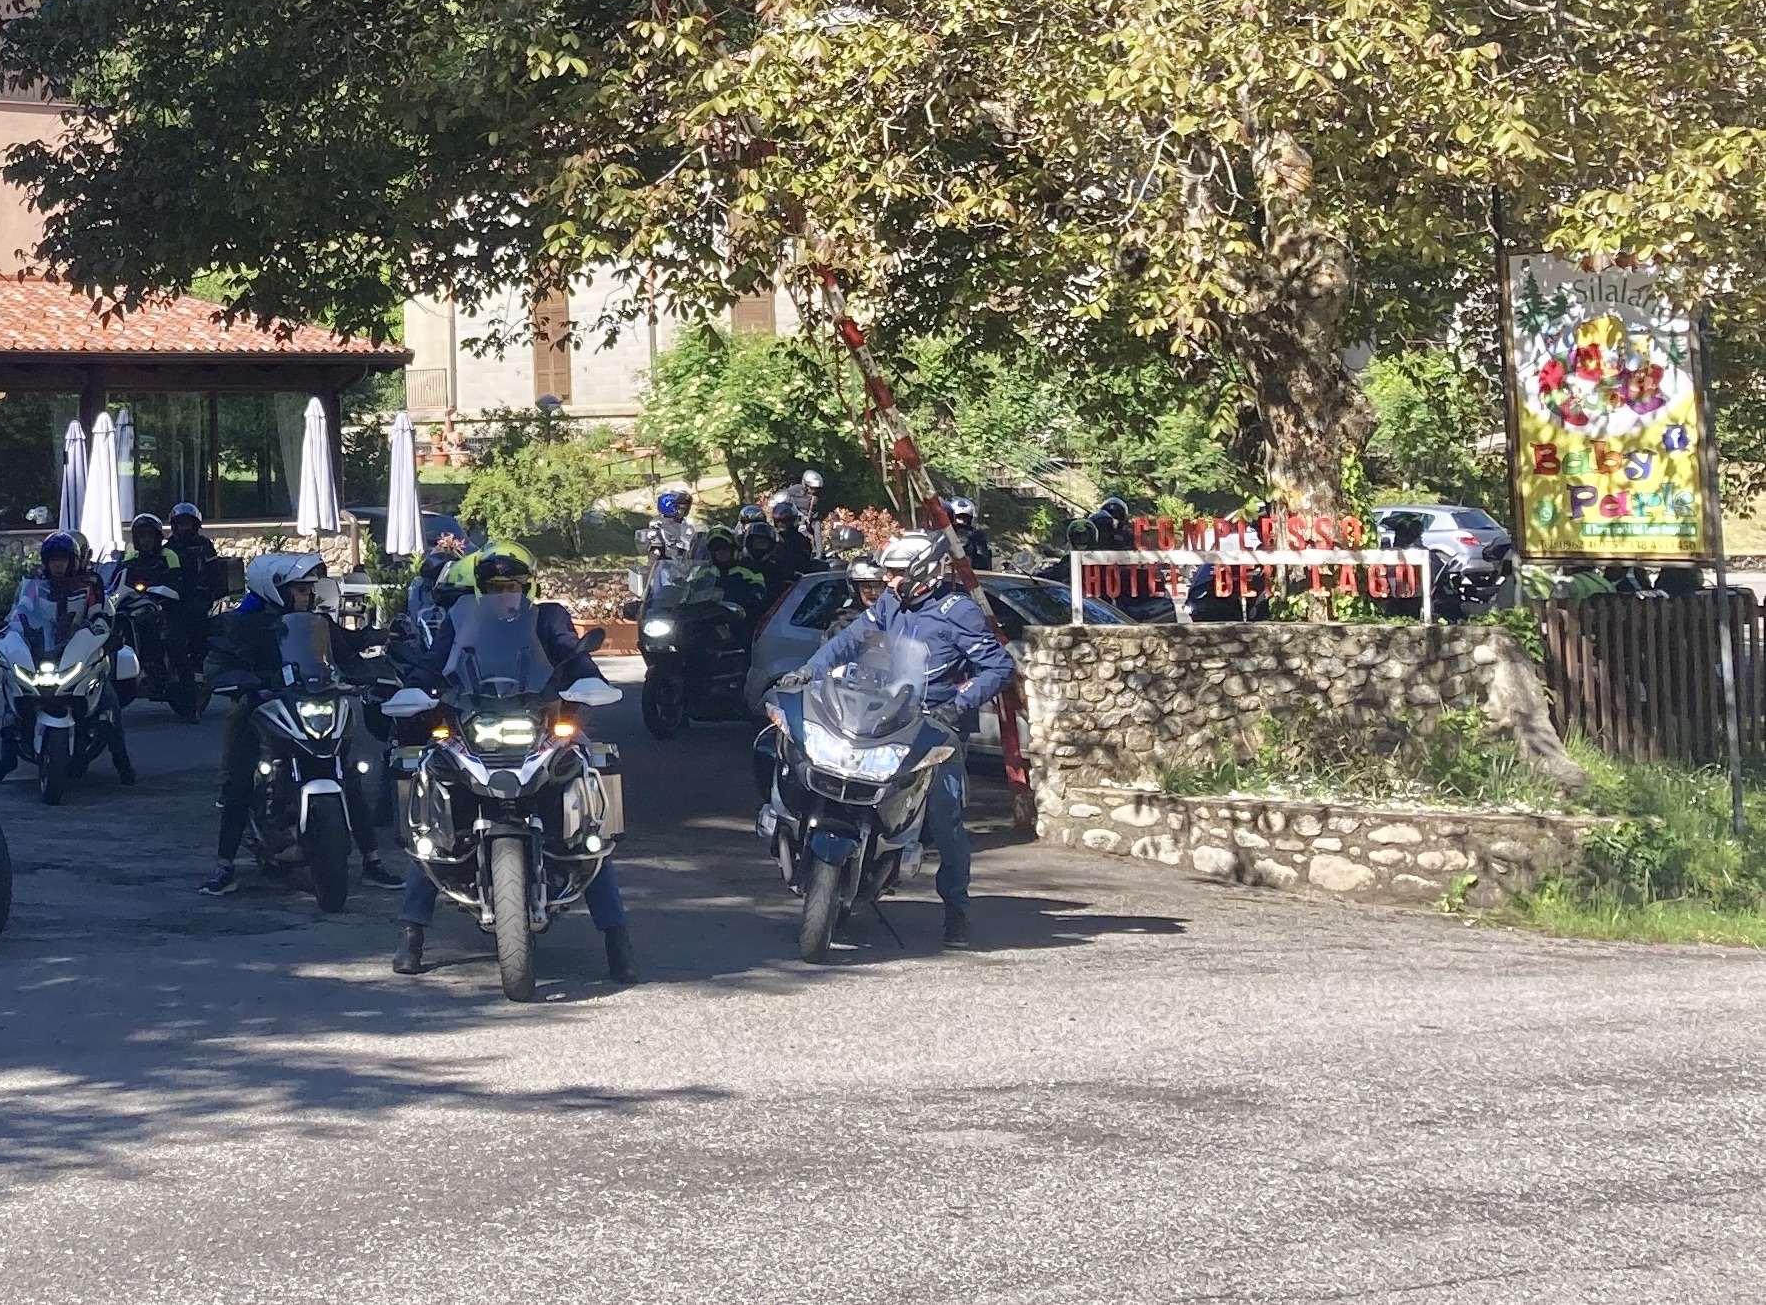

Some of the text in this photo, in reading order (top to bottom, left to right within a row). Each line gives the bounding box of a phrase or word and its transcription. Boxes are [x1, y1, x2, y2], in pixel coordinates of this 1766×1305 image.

[1530, 440, 1656, 480] Baby
[1566, 482, 1694, 519] Park
[1133, 515, 1363, 552] COMPLESSO
[1084, 562, 1185, 599] HOTEL
[1308, 562, 1416, 599] LAGO
